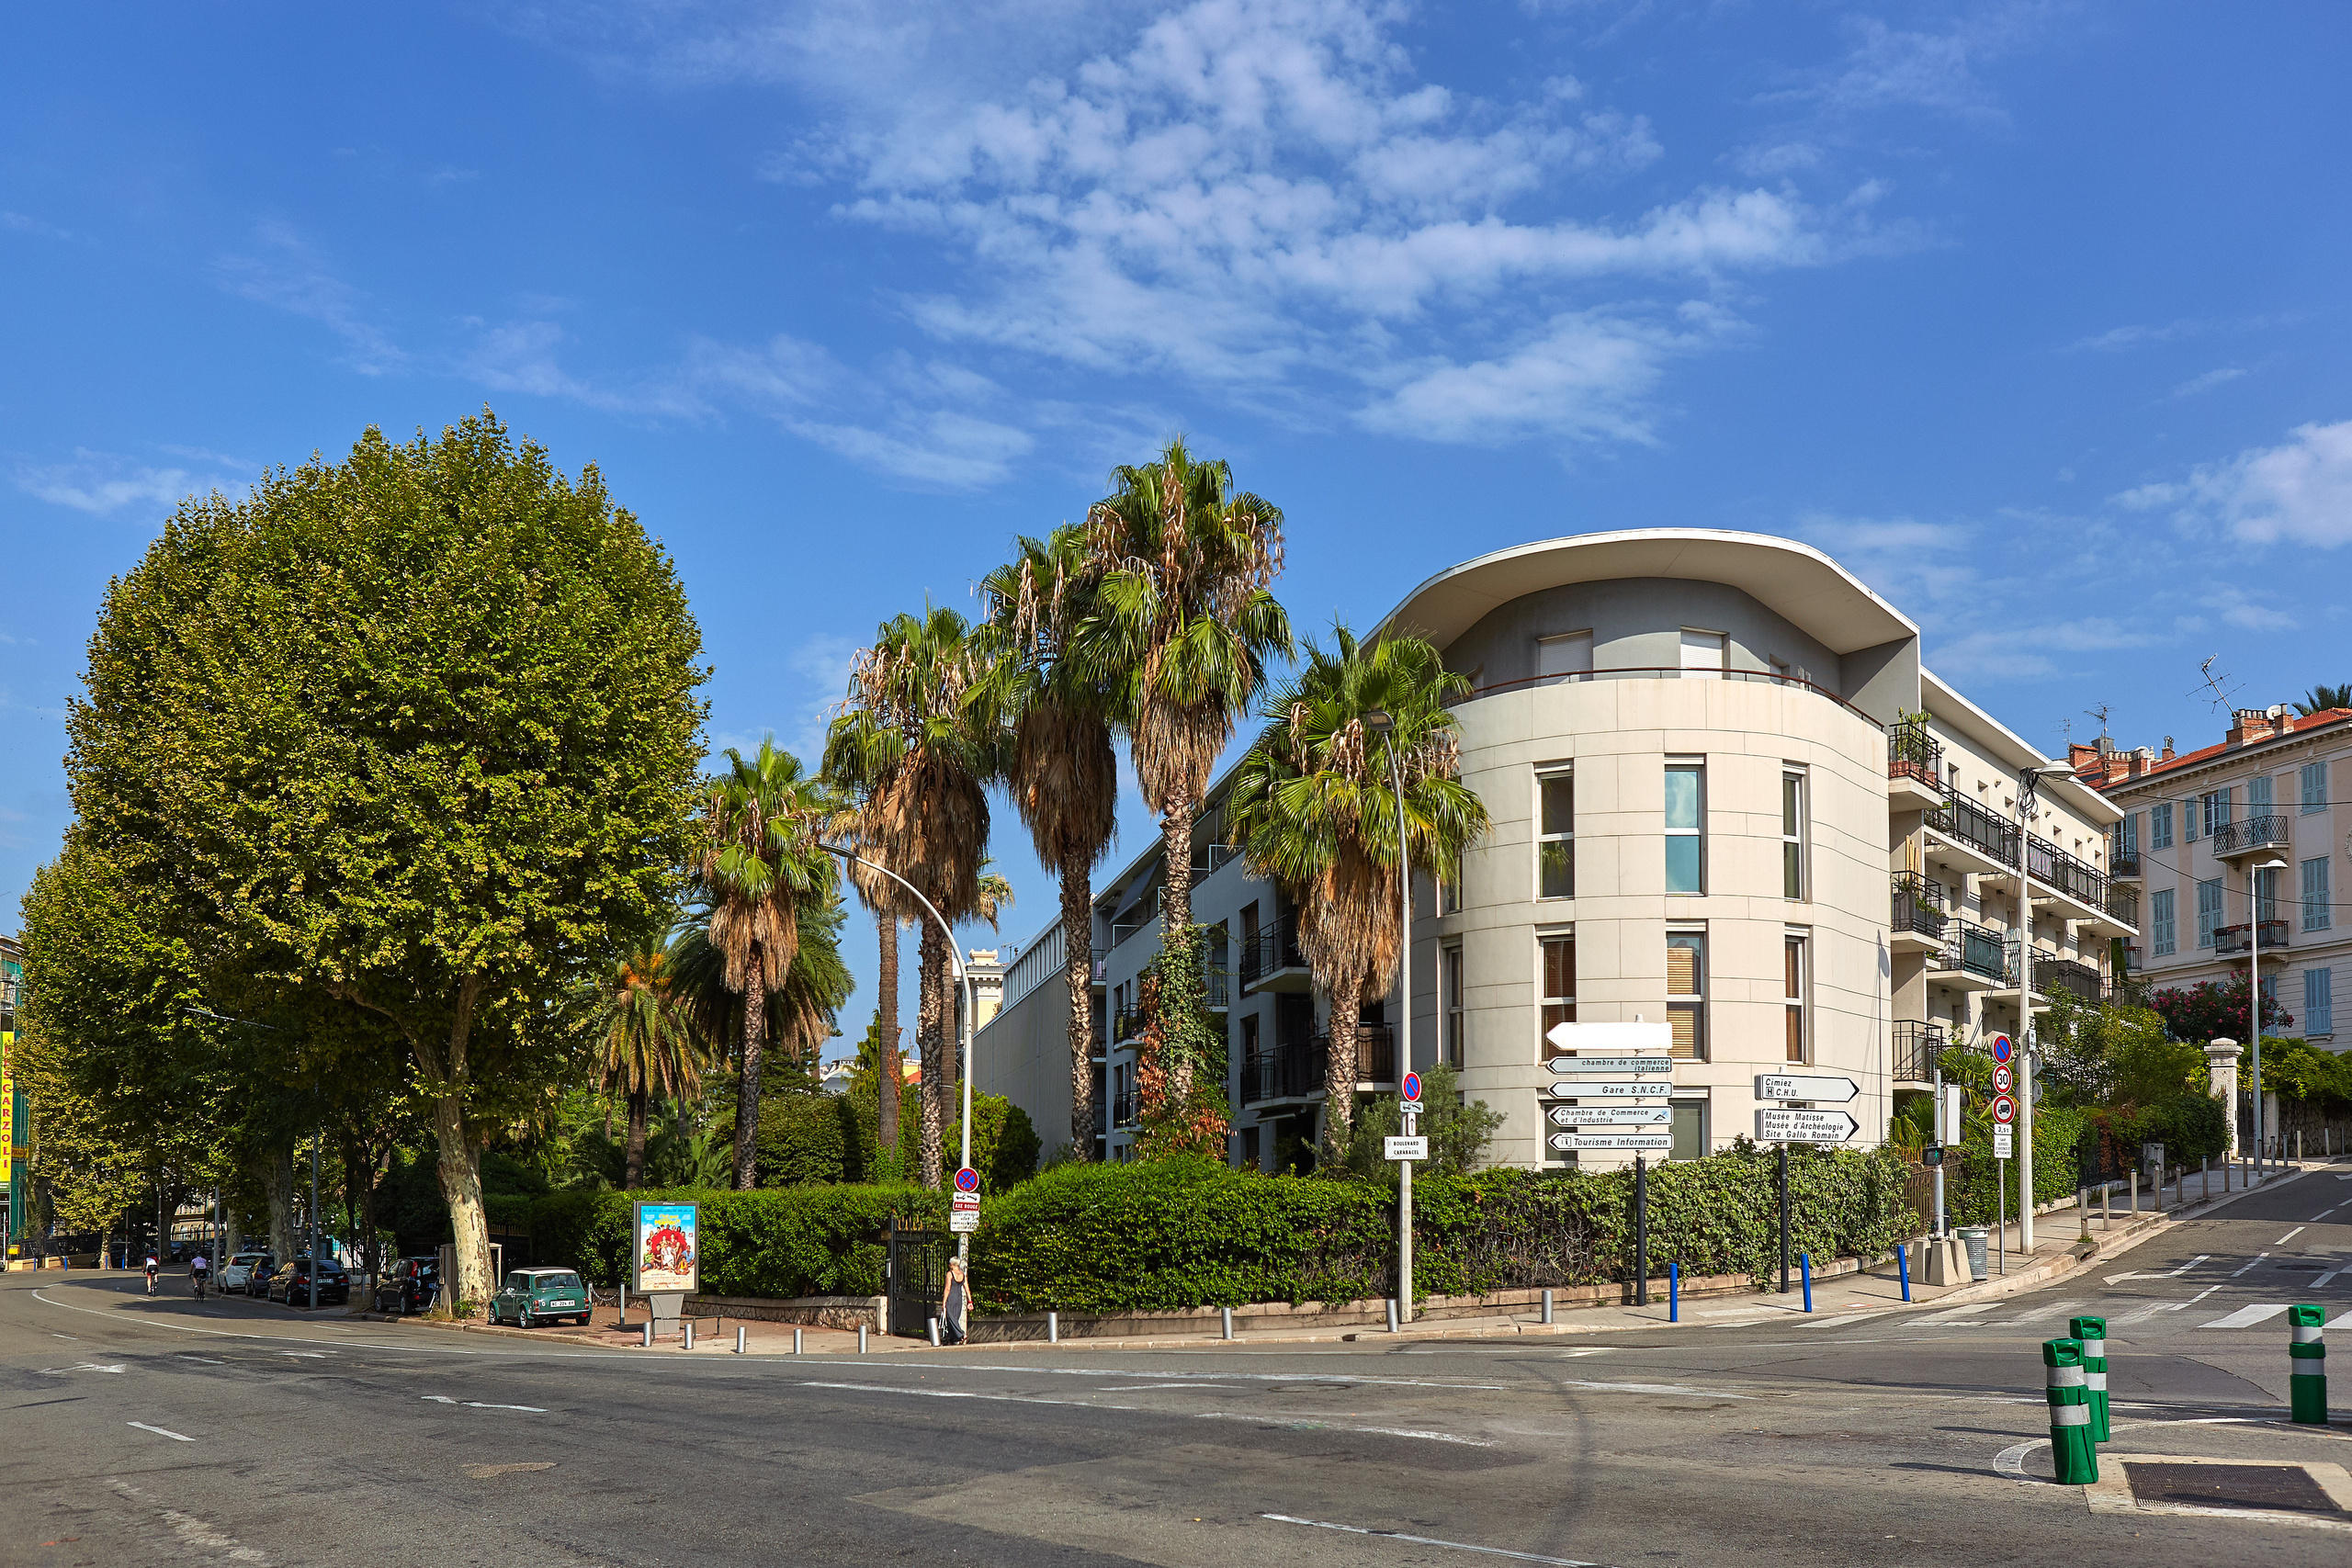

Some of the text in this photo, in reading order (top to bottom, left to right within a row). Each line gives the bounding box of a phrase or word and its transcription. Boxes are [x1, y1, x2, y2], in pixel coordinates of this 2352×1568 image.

[1766, 1078, 1792, 1087] Cimiez
[1997, 1073, 2008, 1085] 30
[1602, 1086, 1668, 1094] Gare S.N.C.F.
[1776, 1089, 1799, 1097] C.H.U.
[2, 1045, 12, 1168] SCARZOLI
[1765, 1112, 1790, 1121] Musée
[1793, 1122, 1844, 1133] d'Archéologie
[1765, 1130, 1781, 1138] Site
[1812, 1131, 1839, 1139] Romain
[1574, 1138, 1612, 1146] Tourisme
[1617, 1138, 1668, 1146] Information
